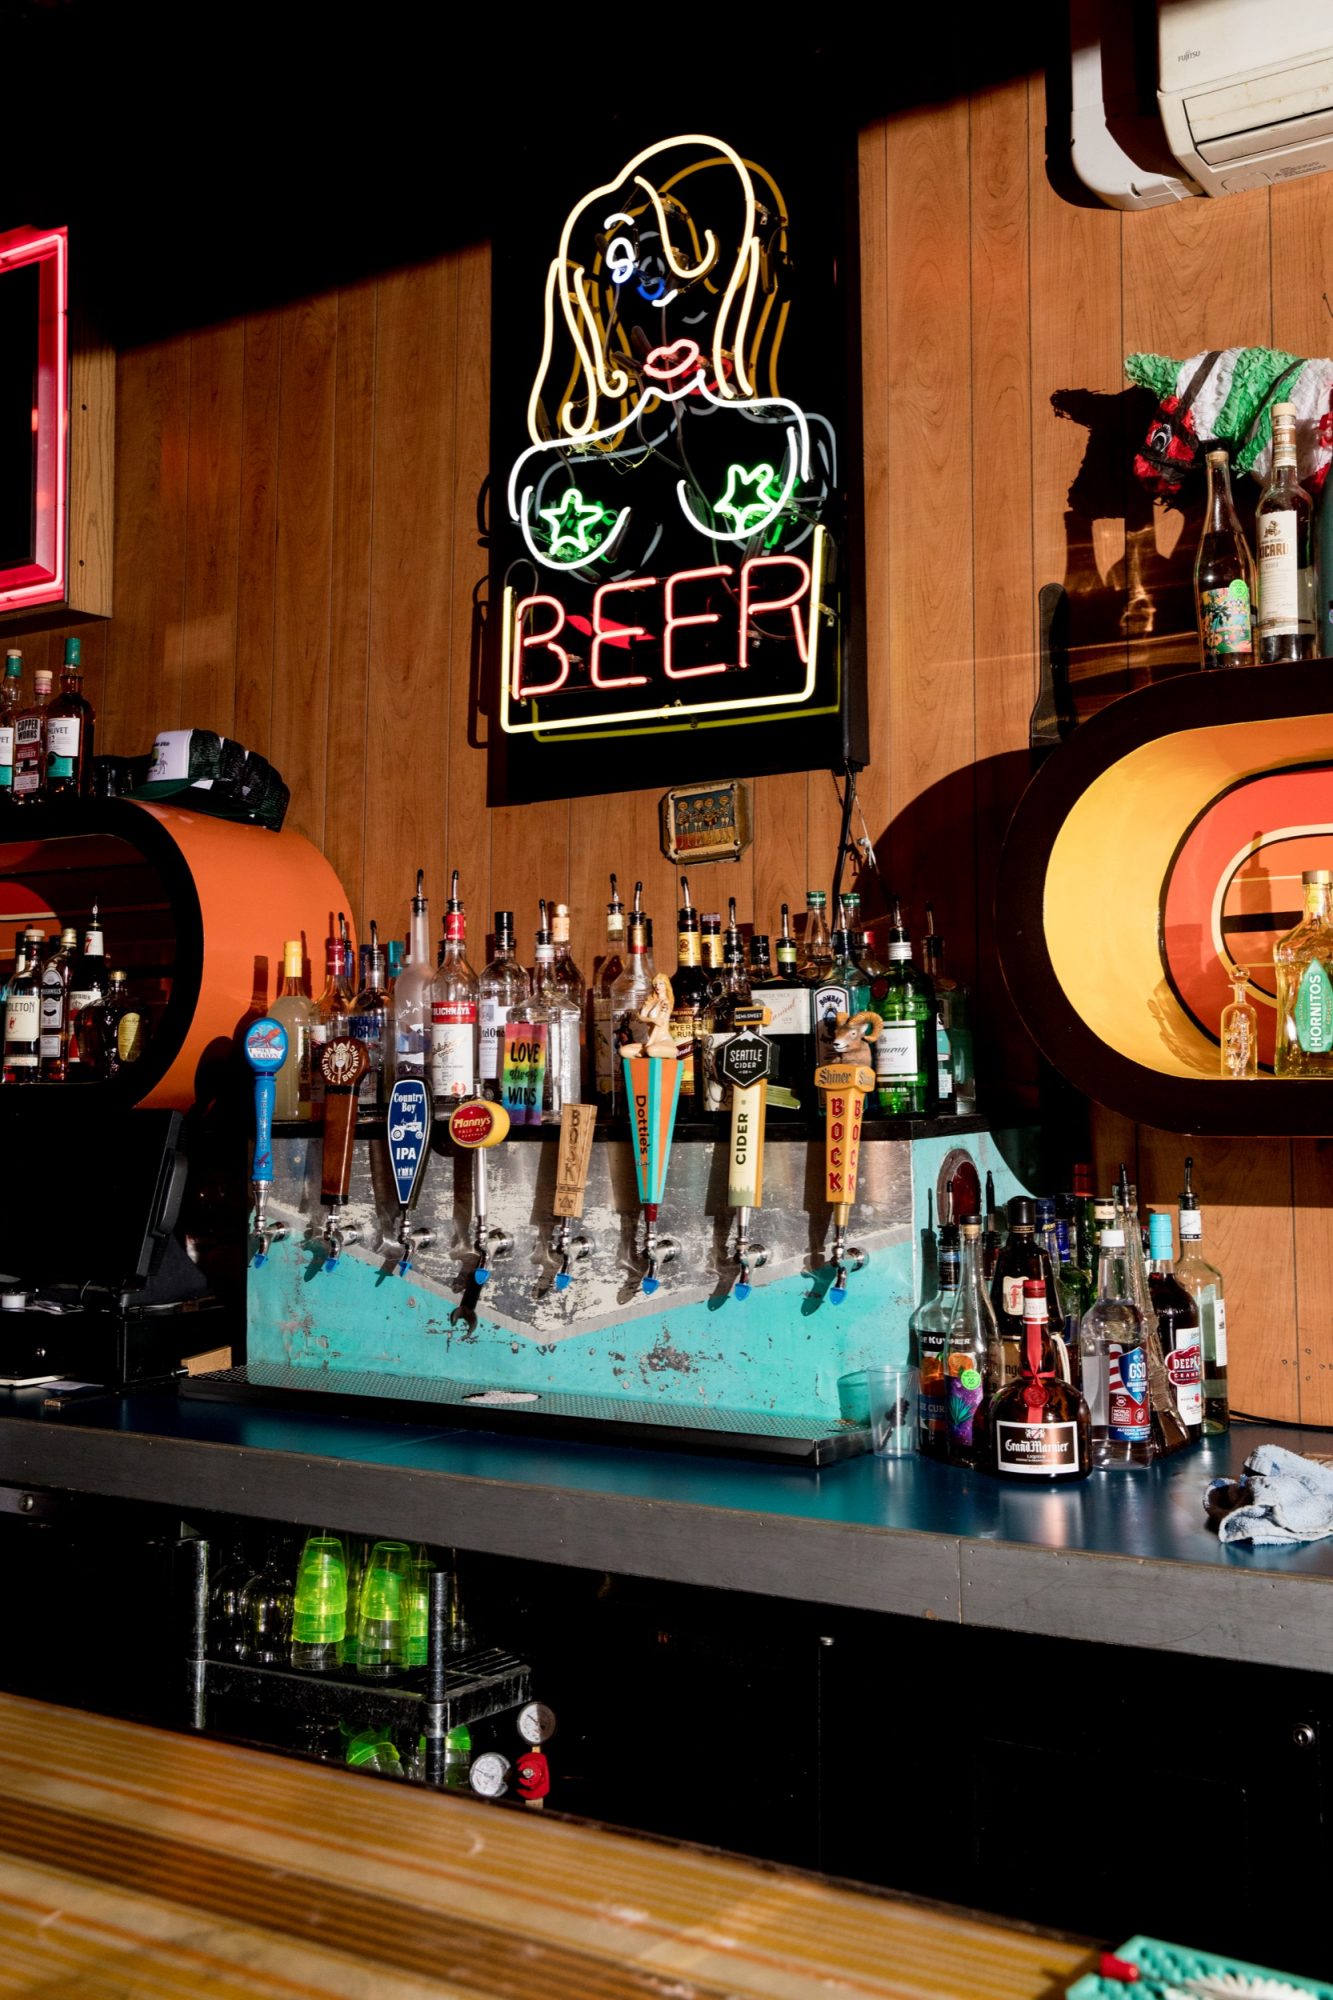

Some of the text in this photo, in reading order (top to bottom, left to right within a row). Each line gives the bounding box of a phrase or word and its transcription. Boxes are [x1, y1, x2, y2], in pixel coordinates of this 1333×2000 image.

[1177, 50, 1200, 62] FUJITSU
[512, 555, 811, 700] BEER
[17, 718, 38, 732] COPPER
[18, 730, 37, 741] WORKS
[819, 994, 842, 1006] BOMBAY
[1309, 974, 1322, 1048] HORNITOS
[510, 1041, 540, 1063] LOVE
[729, 1049, 763, 1063] SEATTLE
[321, 1046, 337, 1083] VALHOLL
[341, 1045, 359, 1082] BREWING
[818, 1069, 852, 1087] Shiner
[394, 1093, 424, 1104] Country
[508, 1086, 537, 1106] WINS
[401, 1103, 417, 1114] Boy
[453, 1116, 491, 1129] Manny's
[635, 1095, 651, 1154] Dottie's
[735, 1113, 749, 1165] CIDER
[828, 1097, 845, 1193] BOCK
[847, 1099, 862, 1193] BOCK
[396, 1147, 417, 1160] IPA
